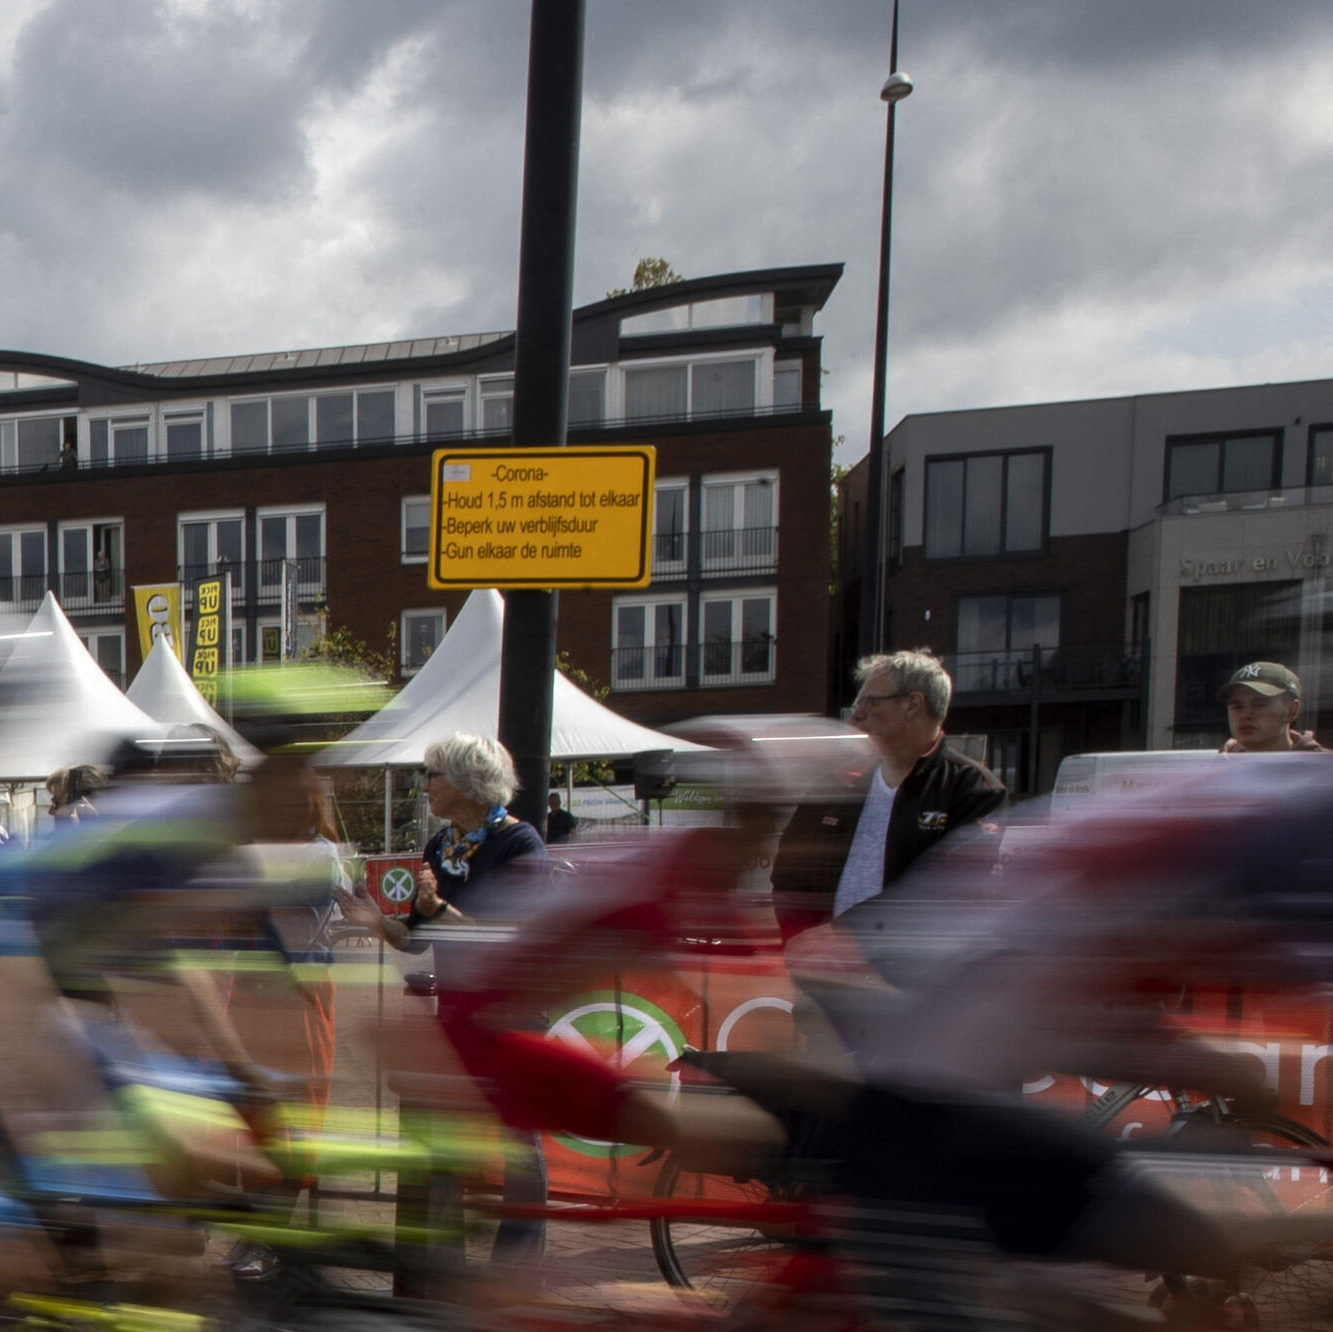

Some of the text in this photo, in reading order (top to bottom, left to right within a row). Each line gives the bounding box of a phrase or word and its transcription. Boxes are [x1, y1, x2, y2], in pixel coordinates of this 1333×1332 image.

[491, 464, 548, 482] -Corona-
[443, 490, 640, 511] -Houd 1,5 m afstand tot elkaar
[443, 516, 598, 537] -Beperk uw verblijfsduur
[442, 542, 582, 560] -Gun elkaar de ruimte
[1180, 549, 1333, 581] Spaar en Voo
